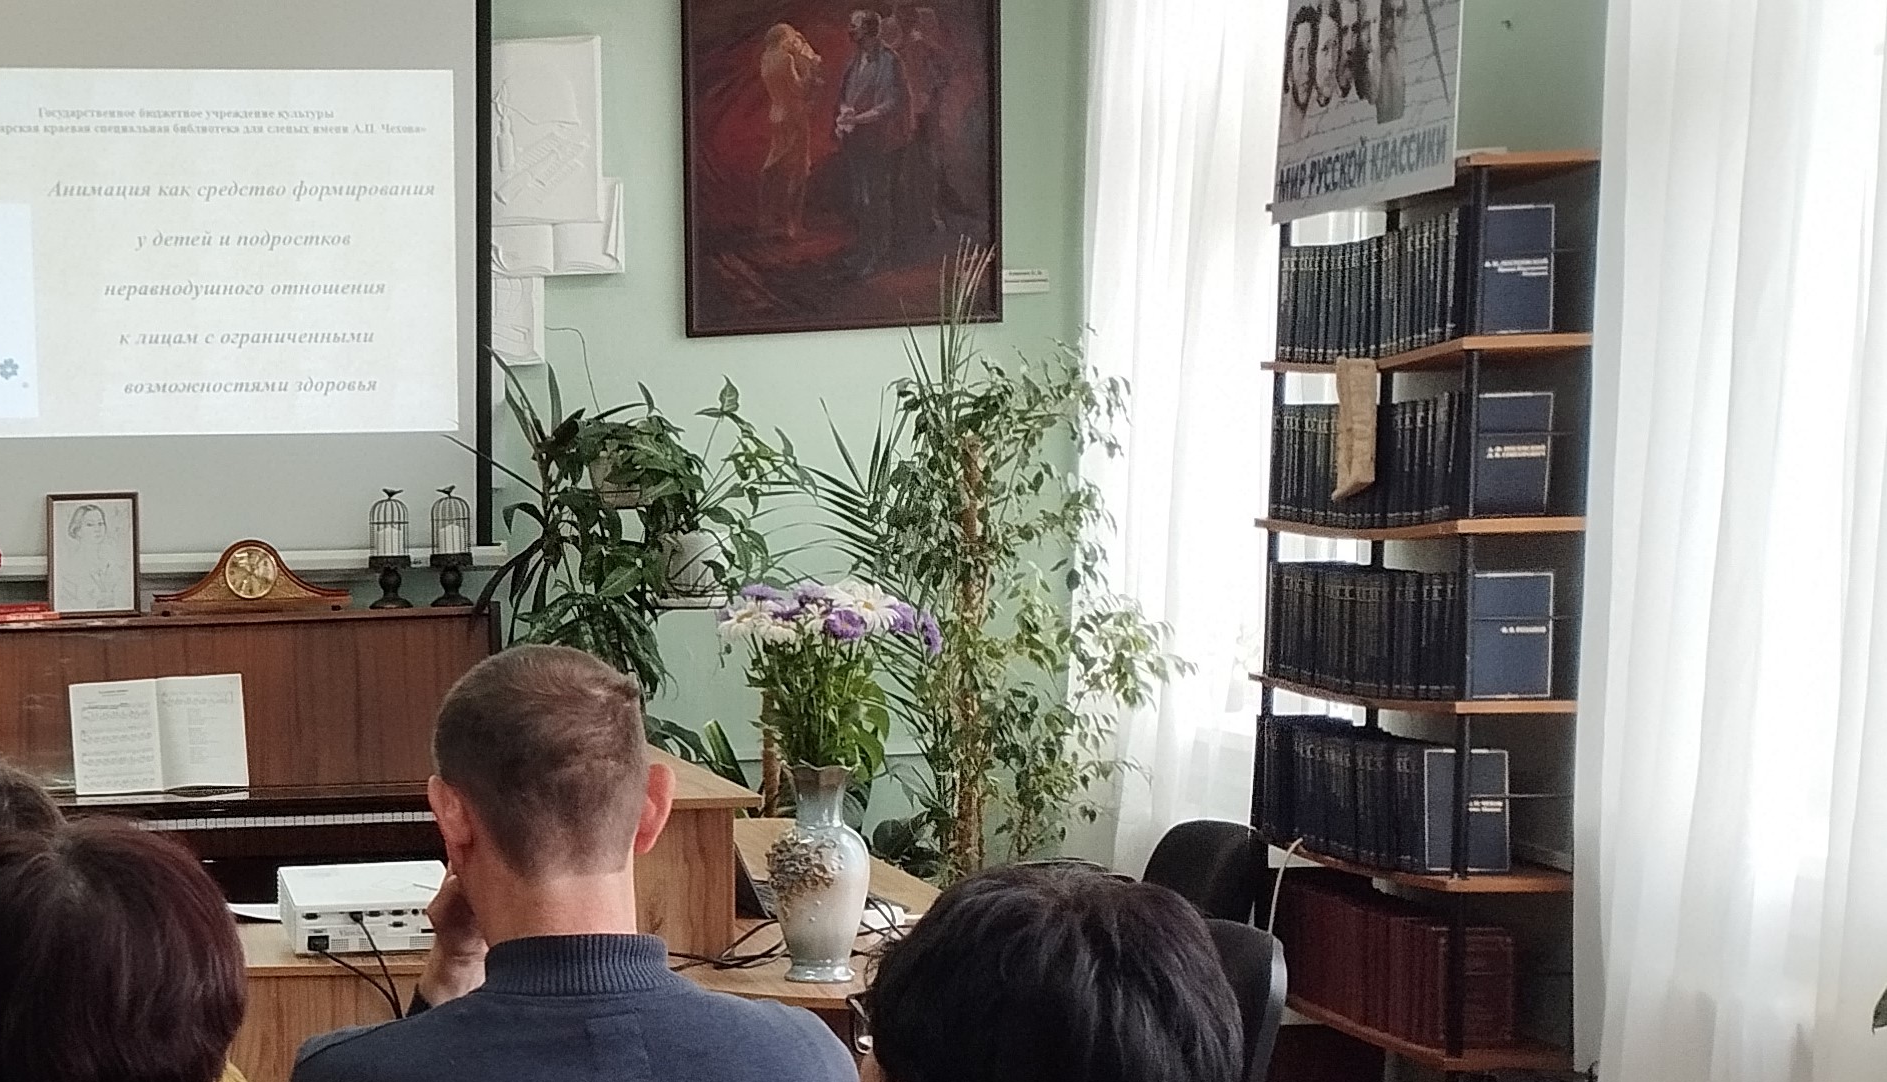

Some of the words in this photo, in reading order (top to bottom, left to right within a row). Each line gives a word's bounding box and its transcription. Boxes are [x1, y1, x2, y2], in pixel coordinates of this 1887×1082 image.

[38, 106, 136, 119] Государственное
[139, 106, 202, 119] бюджетное
[204, 109, 275, 120] учреждение
[278, 108, 335, 120] культуры
[43, 123, 91, 135] краевая
[94, 123, 170, 135] специальная
[172, 122, 241, 135] библиотека
[242, 124, 264, 135] для
[266, 124, 309, 135] слепых
[312, 124, 350, 135] имени
[1277, 162, 1307, 203] МИР
[1308, 135, 1367, 196] РУССКОЙ
[1369, 123, 1447, 183] КЛАССИКИ
[47, 180, 152, 201] Анимация
[157, 184, 192, 198] как
[196, 181, 287, 201] средство
[292, 179, 436, 202] формирования
[134, 232, 148, 252] у
[151, 229, 213, 248] детей
[218, 232, 232, 248] и
[236, 229, 352, 251] подростков
[103, 279, 265, 301] неравнодушного
[269, 281, 387, 297] отношения
[119, 332, 131, 346] к
[135, 331, 198, 349] лицам
[204, 333, 215, 345] с
[219, 330, 376, 350] ограниченными
[123, 378, 290, 395] возможностями
[294, 376, 378, 397] здоровья
